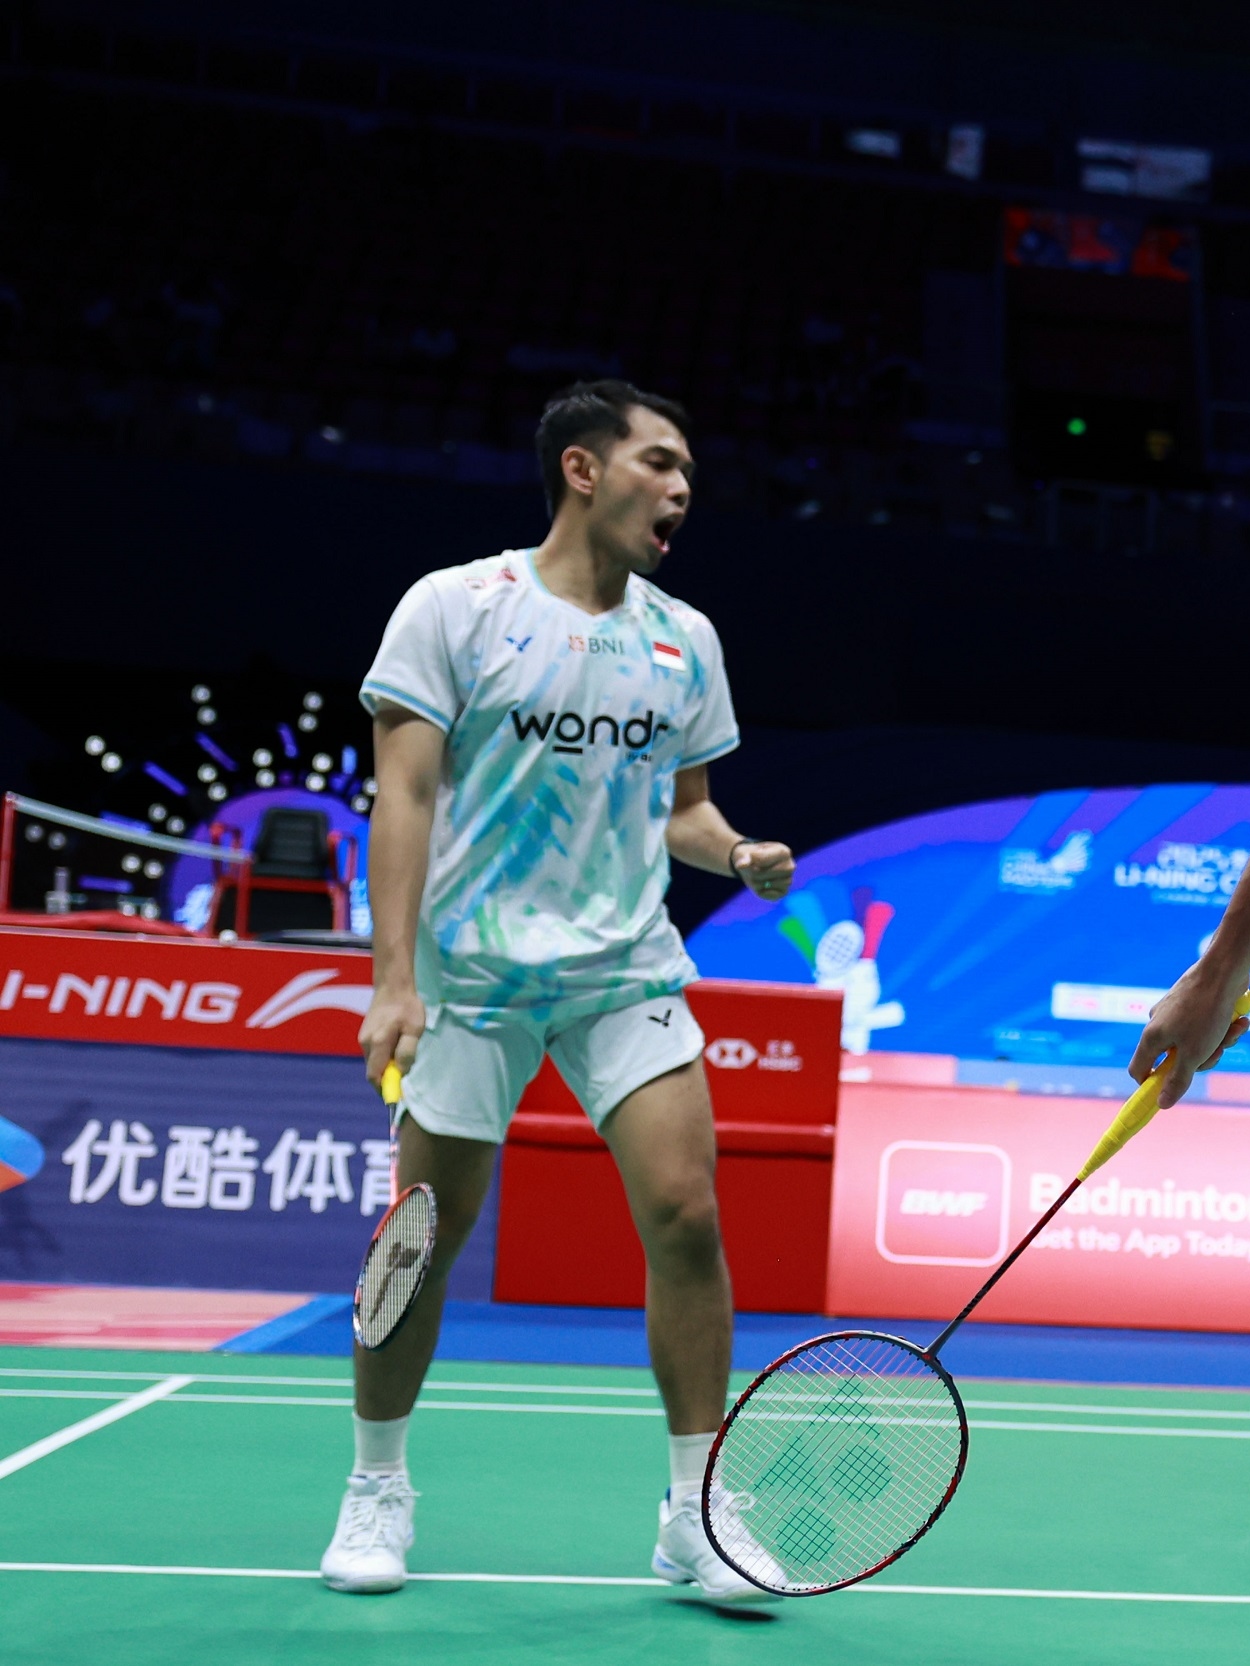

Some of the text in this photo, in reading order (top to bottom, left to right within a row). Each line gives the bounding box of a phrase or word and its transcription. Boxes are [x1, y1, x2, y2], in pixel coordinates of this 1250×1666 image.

[588, 637, 625, 655] BNI
[510, 709, 670, 751] wondr
[0, 969, 243, 1024] I-NING
[900, 1188, 988, 1218] BWF
[1078, 1226, 1121, 1253] the
[1124, 1228, 1182, 1260] App
